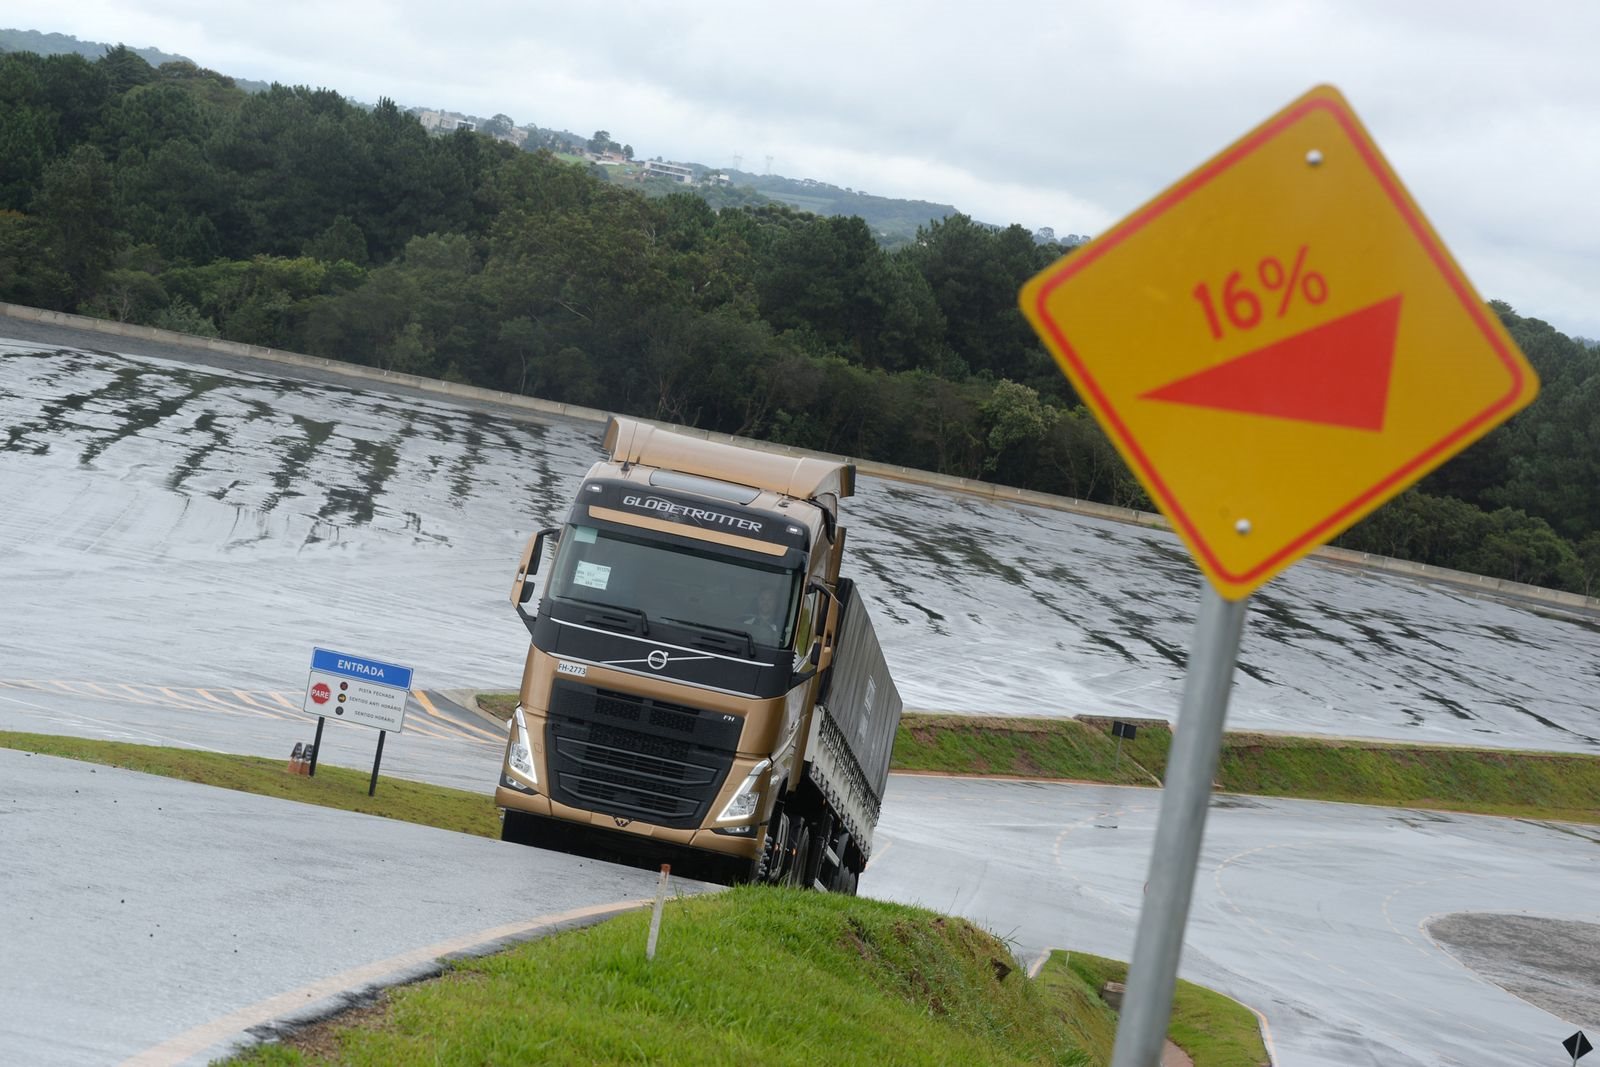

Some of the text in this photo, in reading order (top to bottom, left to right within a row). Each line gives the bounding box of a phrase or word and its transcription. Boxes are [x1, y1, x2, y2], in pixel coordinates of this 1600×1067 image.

[1193, 245, 1328, 340] 16%
[623, 495, 763, 533] GLOBETROTTER
[337, 659, 384, 678] ENTRADA
[558, 662, 586, 675] FH-2773
[311, 688, 329, 699] PARE
